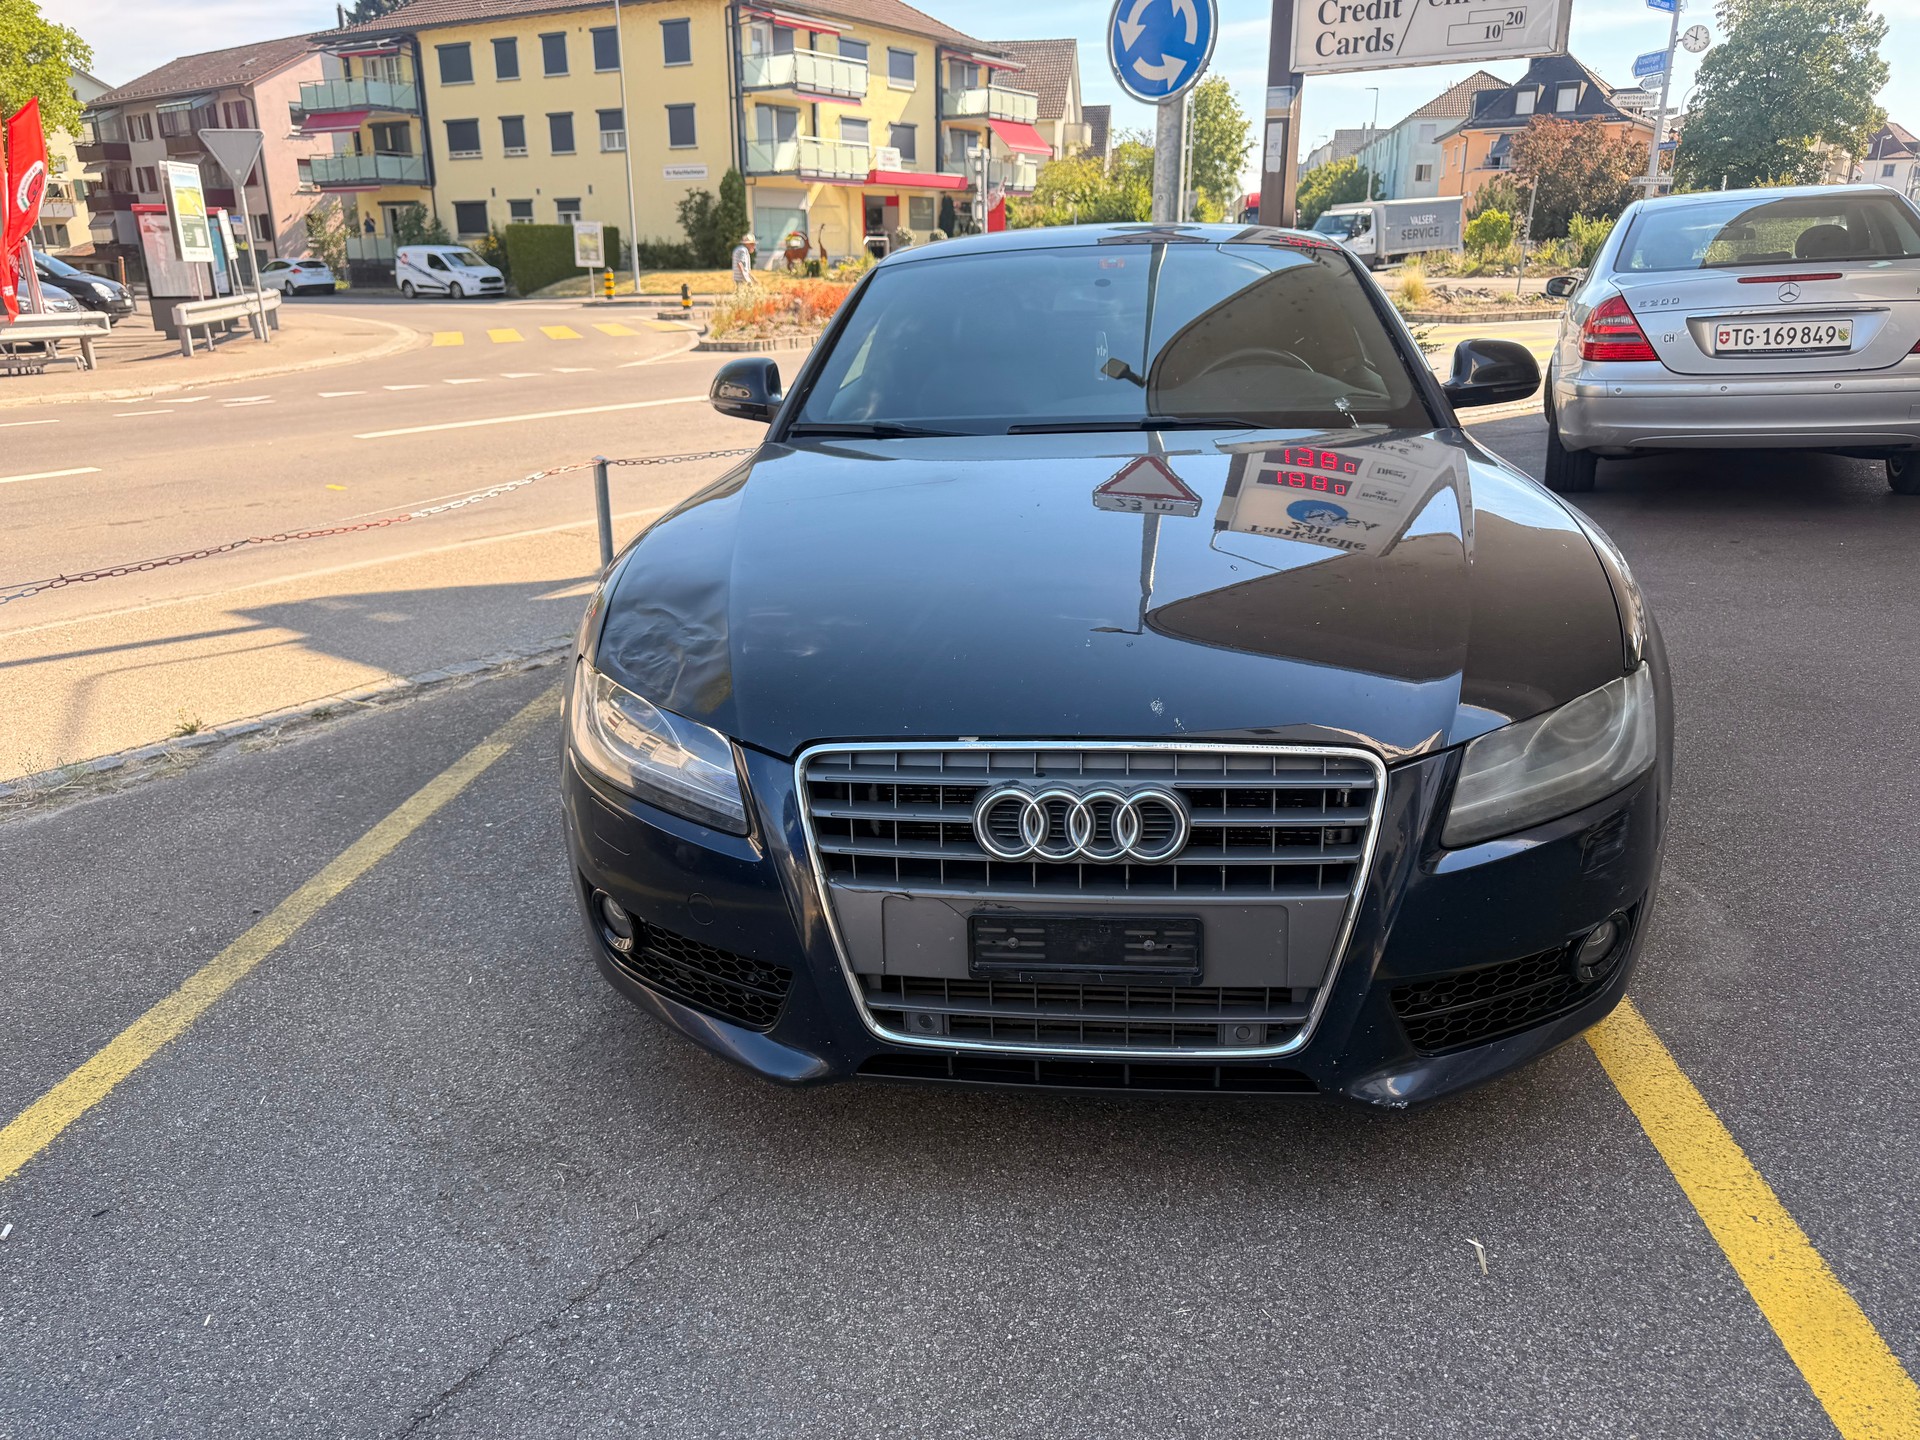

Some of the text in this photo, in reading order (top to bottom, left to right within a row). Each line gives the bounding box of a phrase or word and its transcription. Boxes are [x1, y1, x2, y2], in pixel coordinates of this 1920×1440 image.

[1317, 0, 1402, 25] Credit
[1505, 11, 1524, 26] 20
[1484, 24, 1501, 40] 10
[1315, 27, 1395, 57] Cards
[1401, 226, 1440, 240] SERVICE
[1663, 333, 1675, 343] CH
